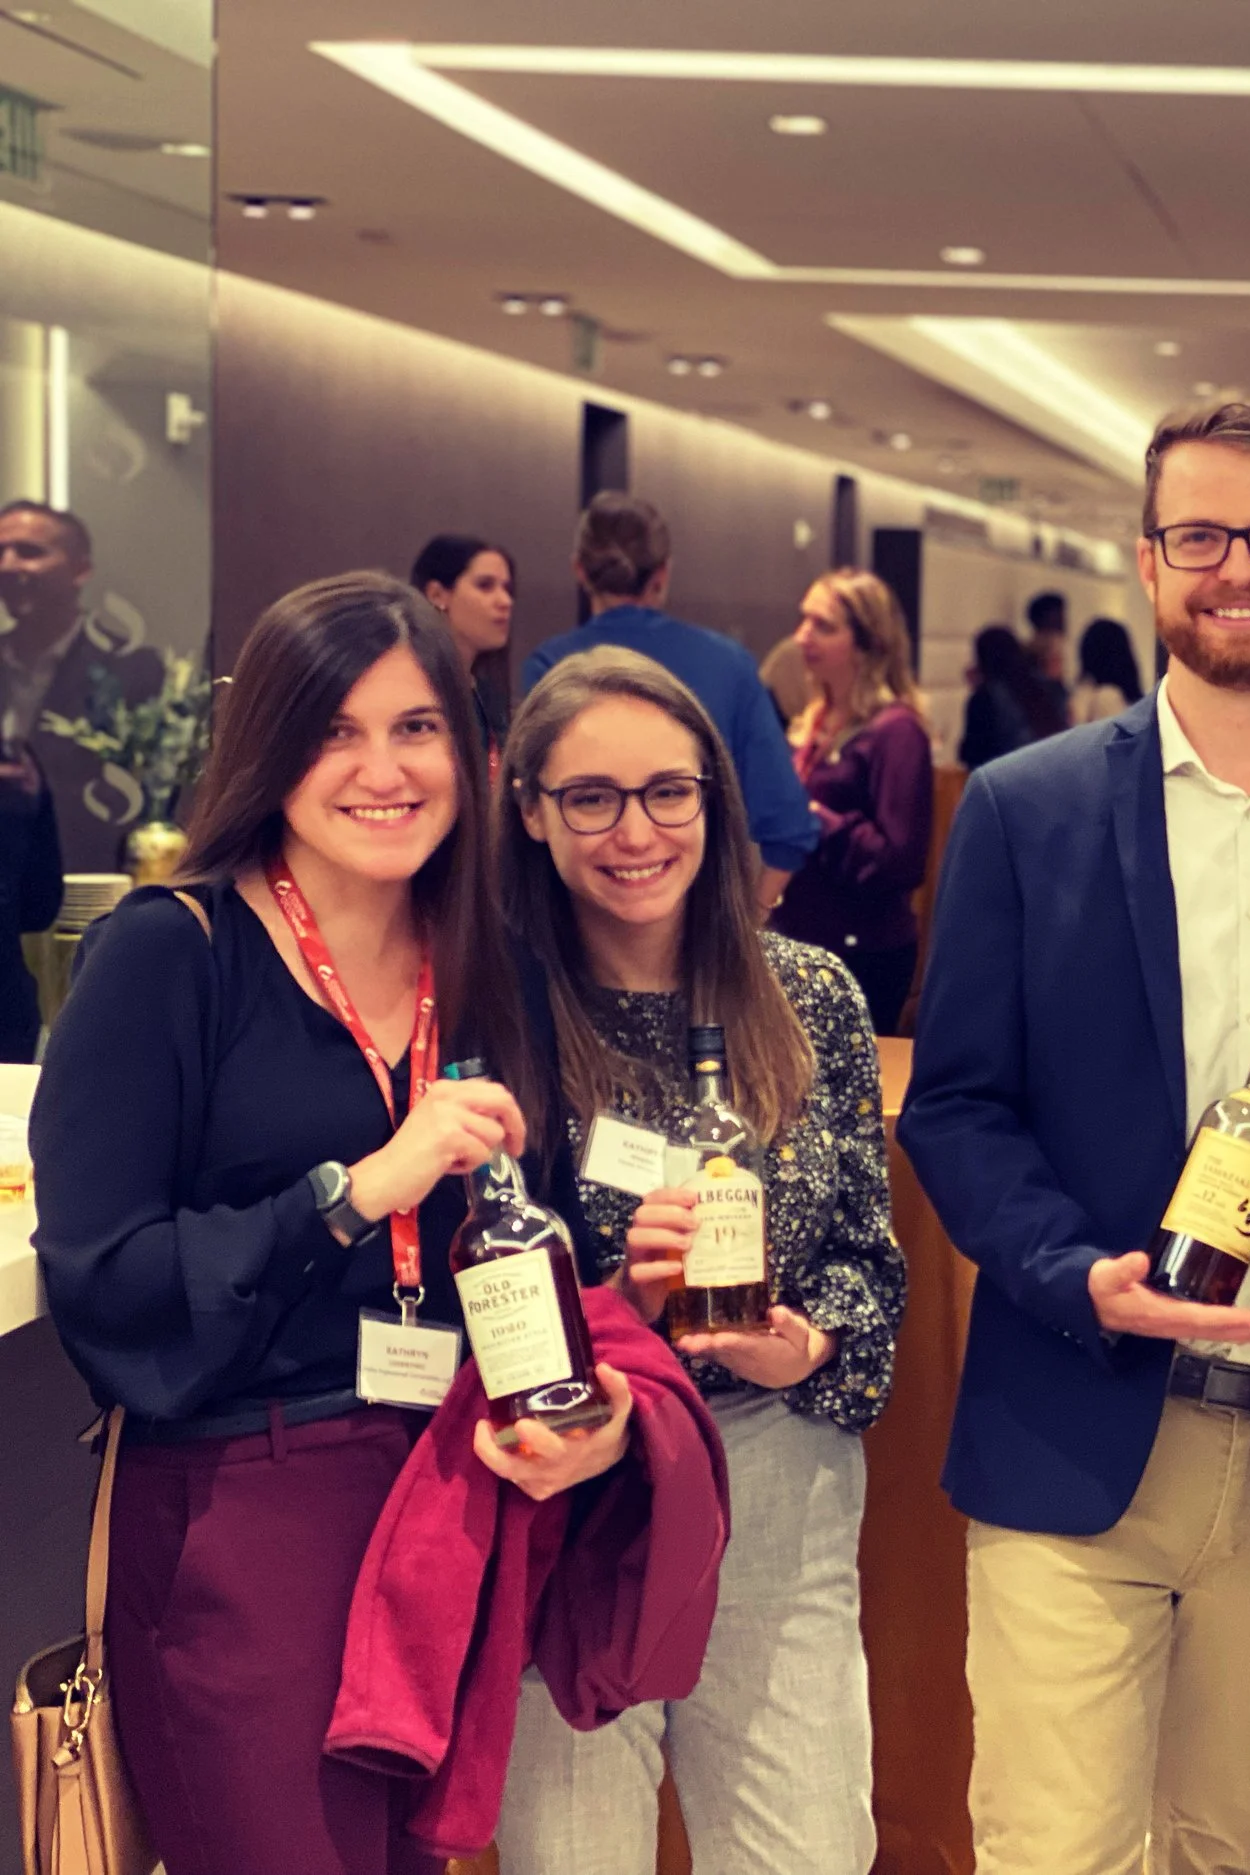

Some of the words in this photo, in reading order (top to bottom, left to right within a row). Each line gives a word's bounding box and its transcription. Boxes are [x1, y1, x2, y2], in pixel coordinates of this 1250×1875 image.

[697, 1187, 759, 1209] LBEGGAN
[483, 1280, 511, 1295] OLD
[468, 1284, 540, 1316] FORESTER
